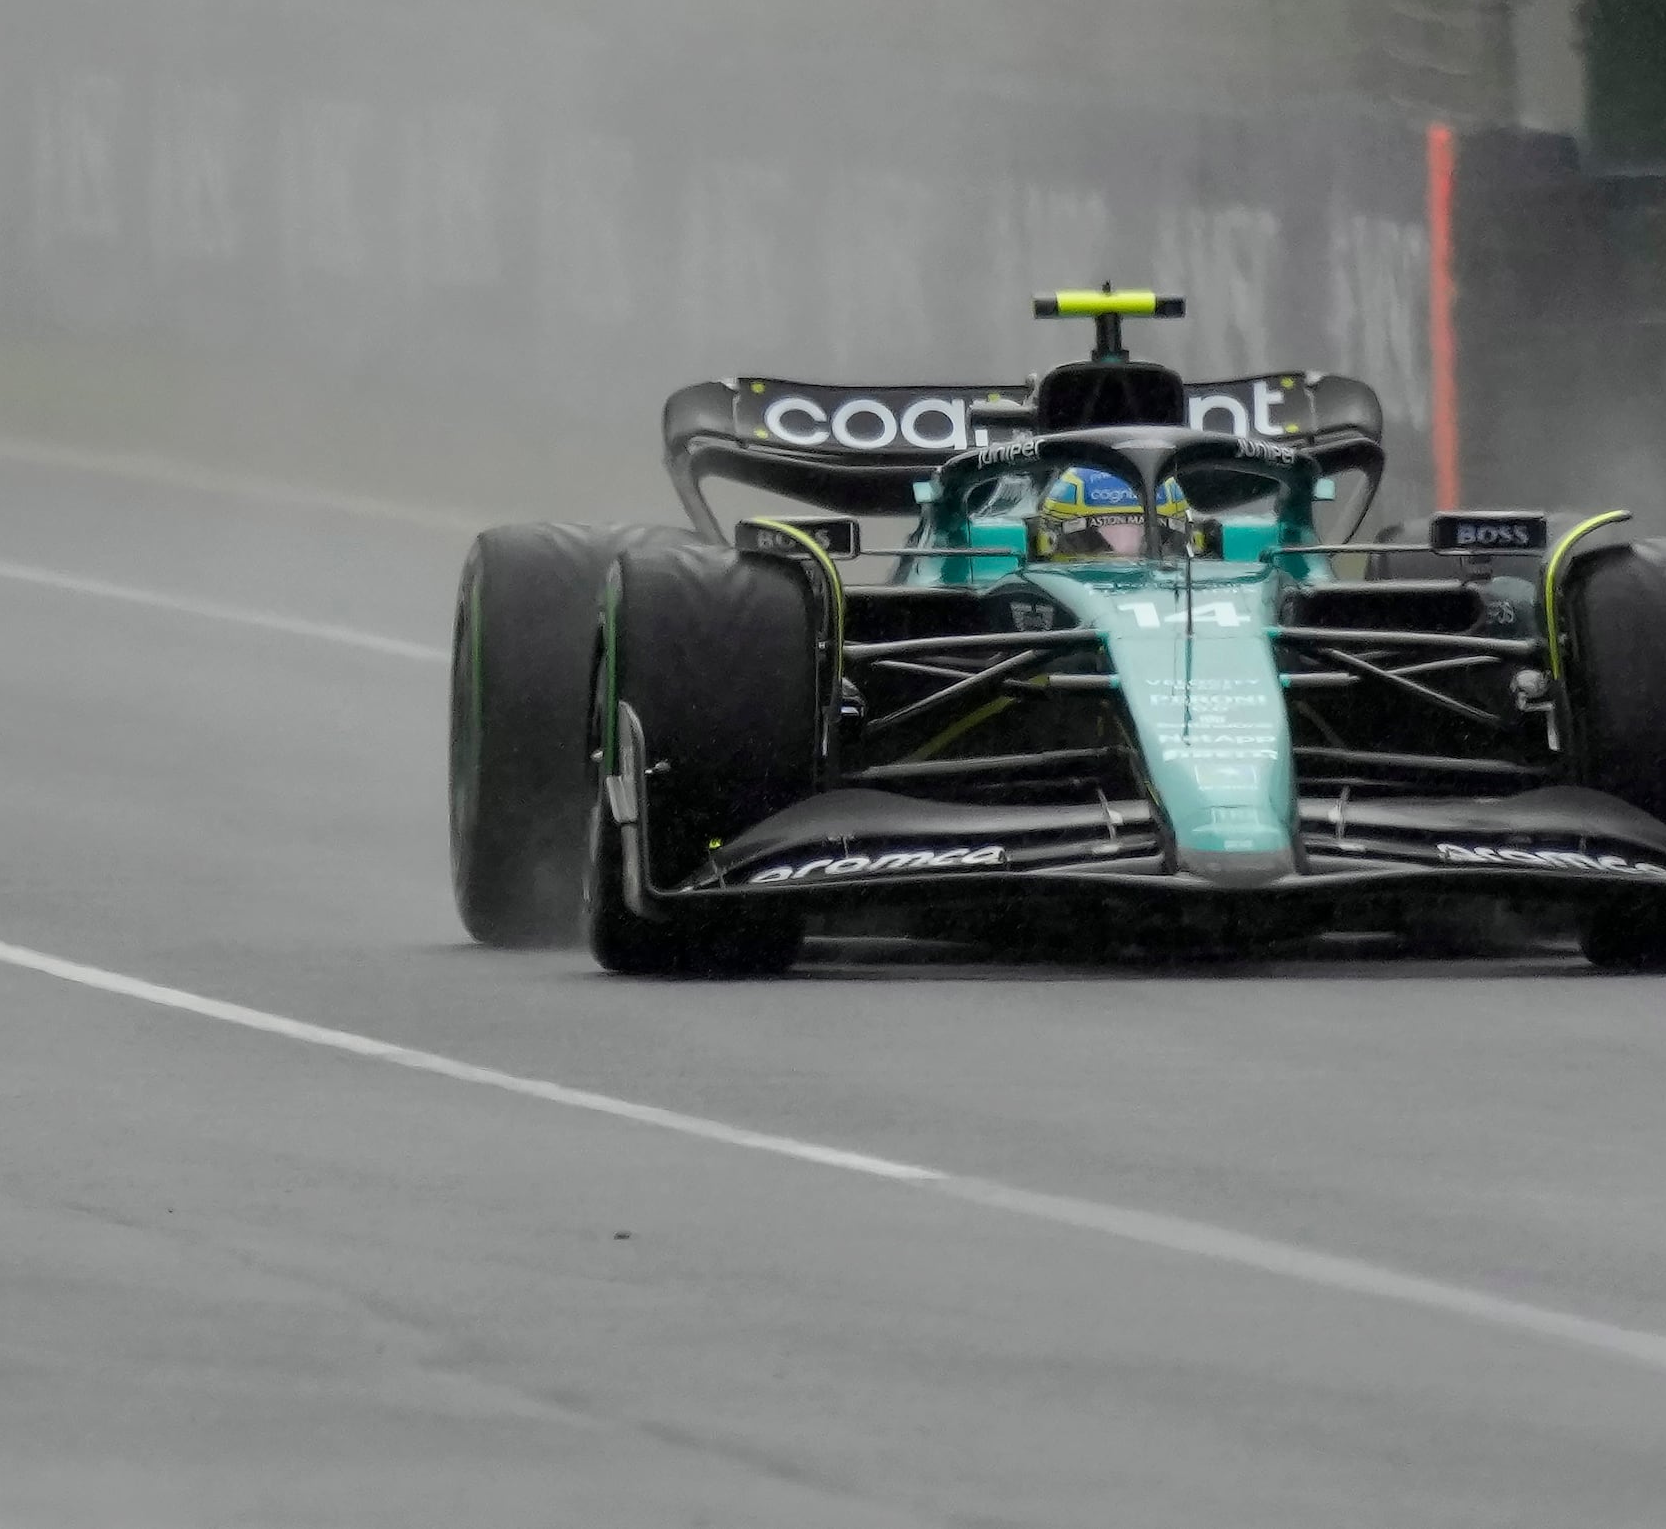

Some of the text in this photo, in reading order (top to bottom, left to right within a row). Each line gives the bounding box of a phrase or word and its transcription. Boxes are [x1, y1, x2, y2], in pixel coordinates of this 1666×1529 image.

[1457, 523, 1530, 545] BOSS
[1117, 602, 1251, 628] 14
[750, 845, 1009, 883] aramco
